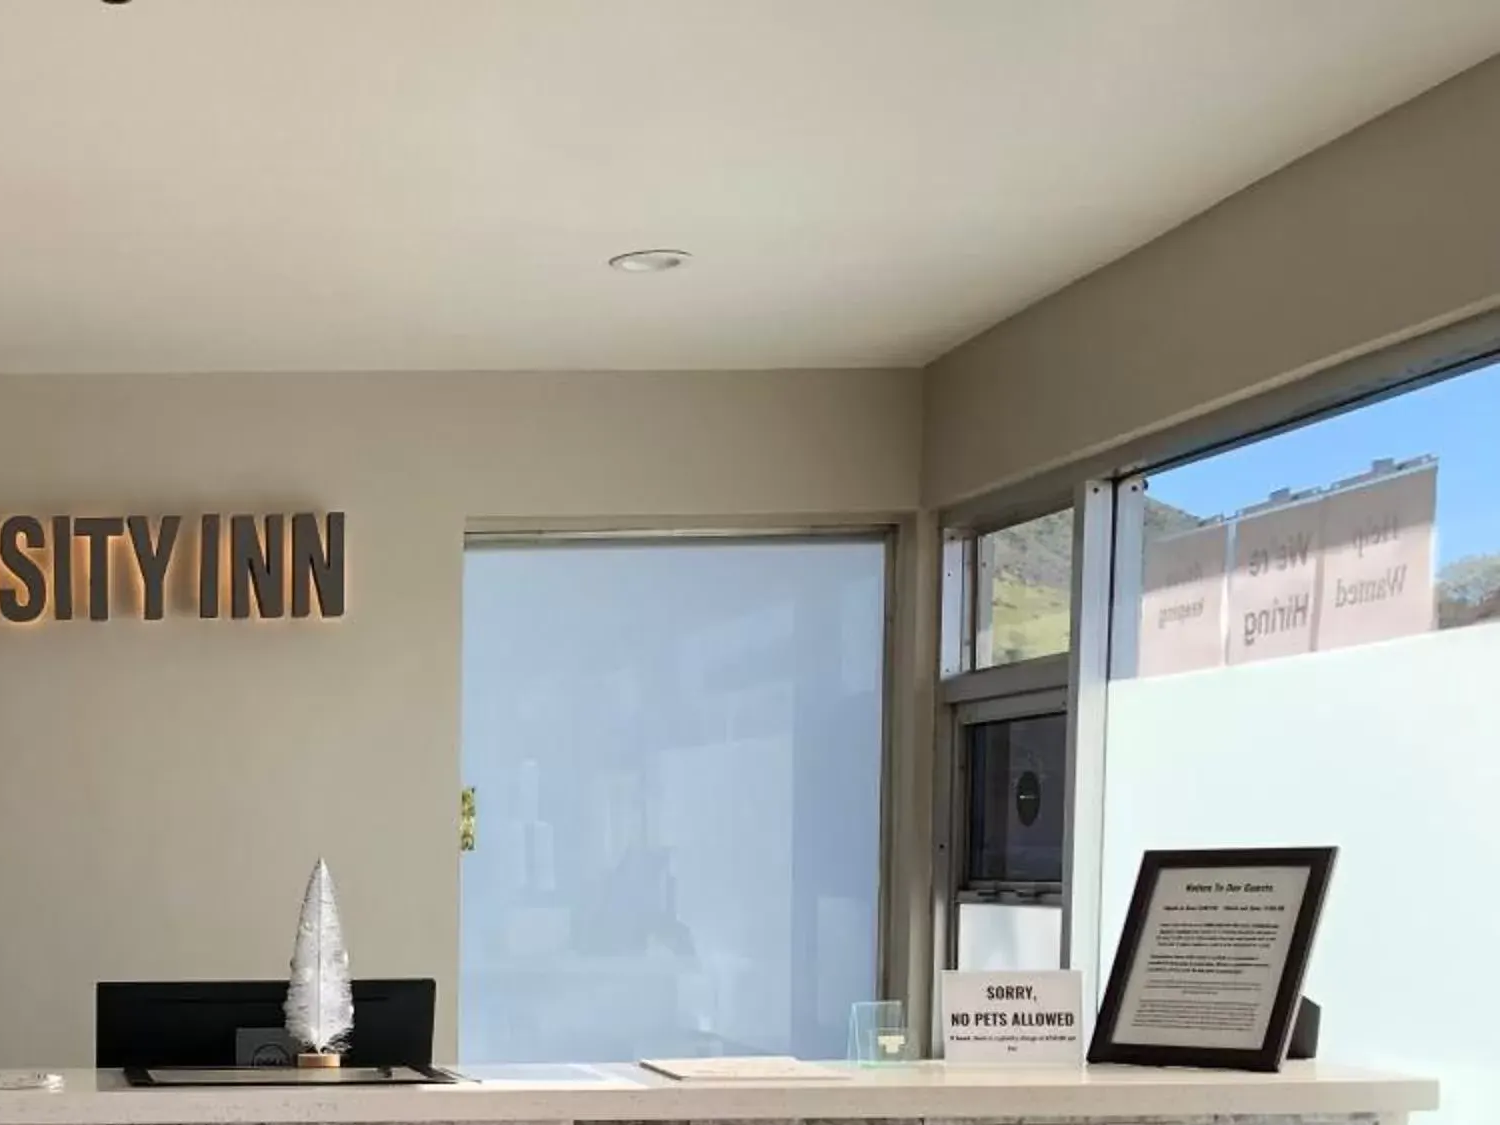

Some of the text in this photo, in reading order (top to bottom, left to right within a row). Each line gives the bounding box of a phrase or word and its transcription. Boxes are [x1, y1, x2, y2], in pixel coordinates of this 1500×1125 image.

[200, 511, 346, 620] INN
[986, 985, 1037, 1002] SORRY,
[951, 1012, 1075, 1027] NO PETS ALLOWED
